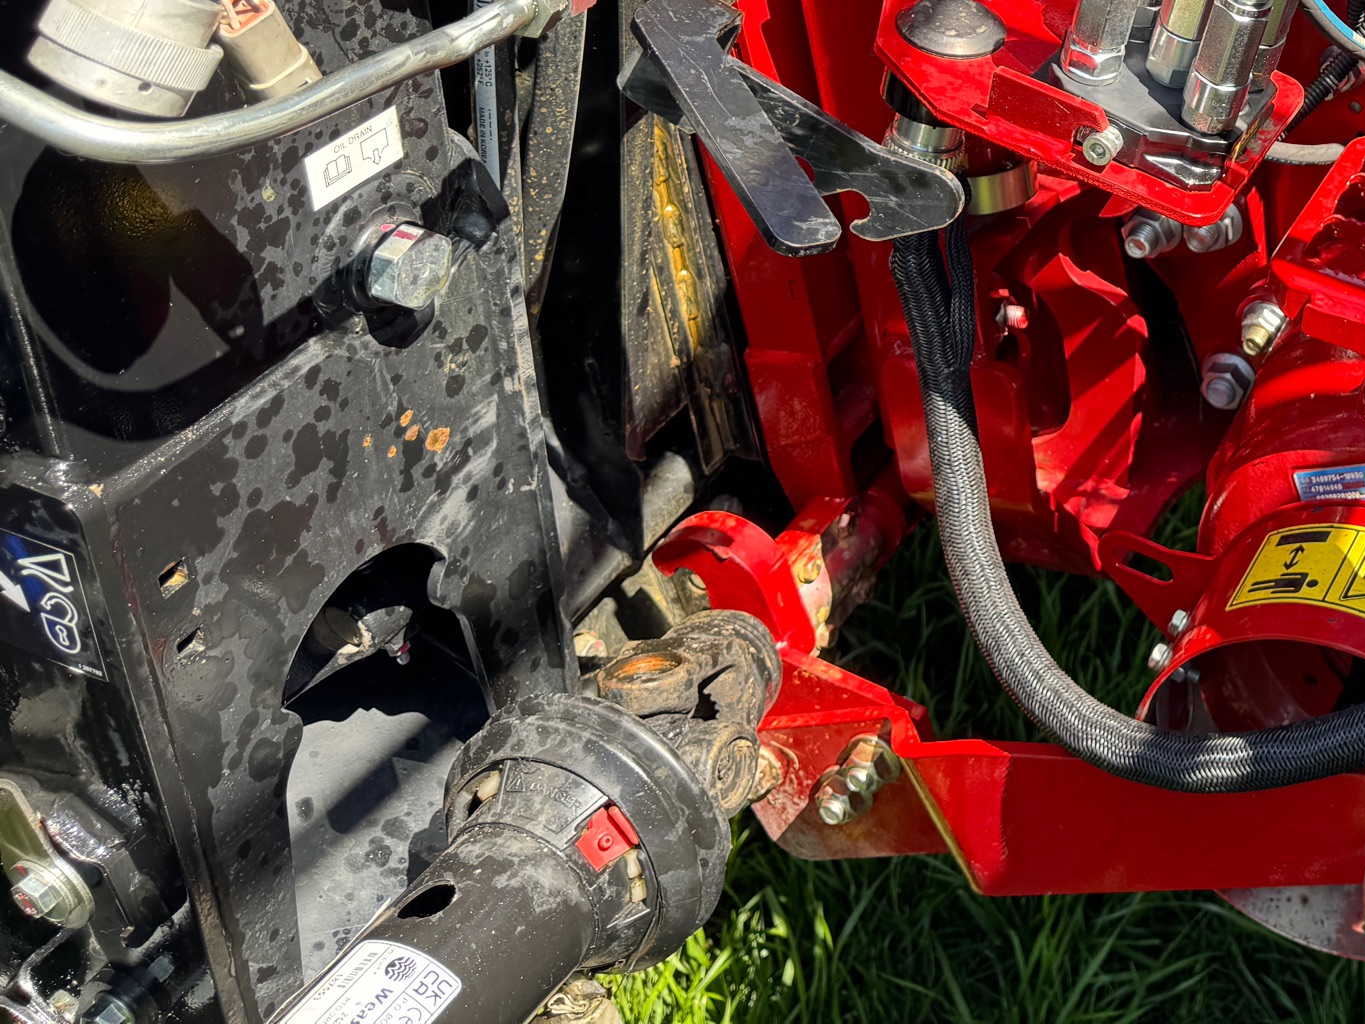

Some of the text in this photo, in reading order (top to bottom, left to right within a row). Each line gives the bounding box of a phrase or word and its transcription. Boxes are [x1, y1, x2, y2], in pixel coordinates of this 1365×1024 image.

[333, 125, 373, 154] OIL DRAIN
[480, 130, 487, 138] IN
[480, 139, 488, 164] KOREA
